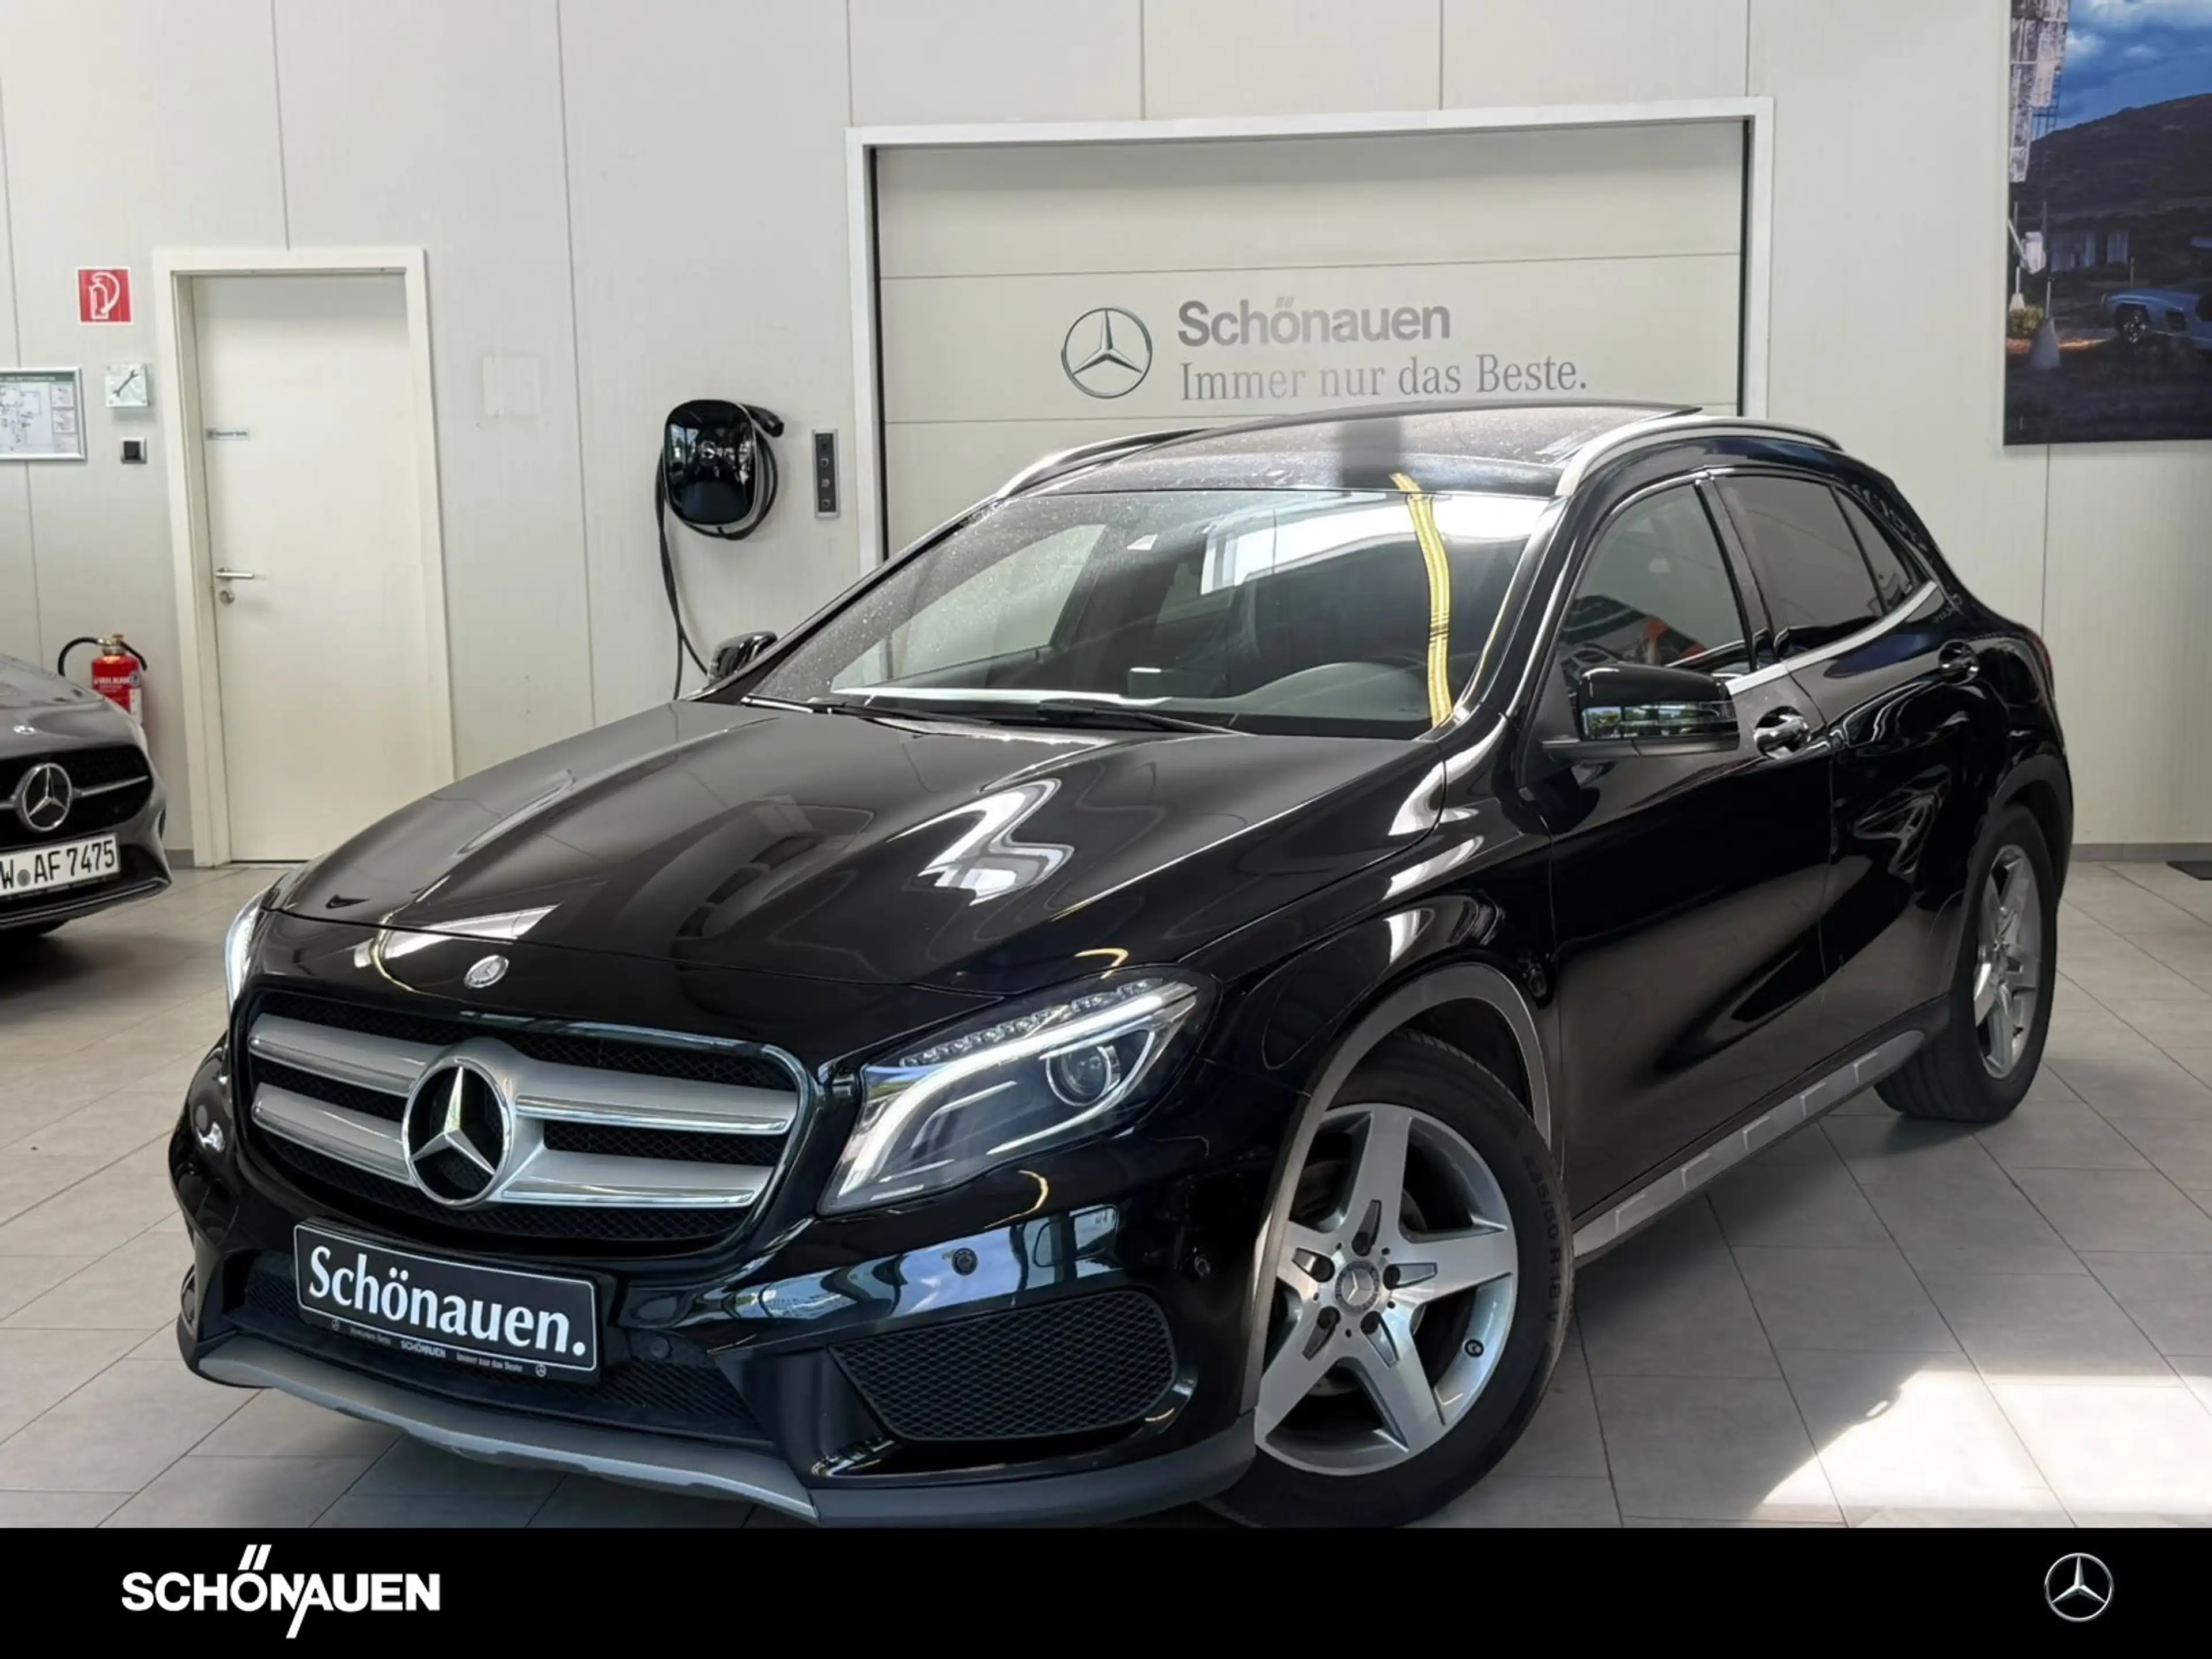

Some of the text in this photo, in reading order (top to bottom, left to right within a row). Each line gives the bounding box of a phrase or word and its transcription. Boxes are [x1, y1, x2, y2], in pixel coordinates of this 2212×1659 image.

[1178, 296, 1450, 346] Schönauen
[1180, 353, 1587, 400] Immer nur das Beste.
[0, 839, 115, 889] W AF 7475
[309, 1245, 586, 1357] Schönauen.
